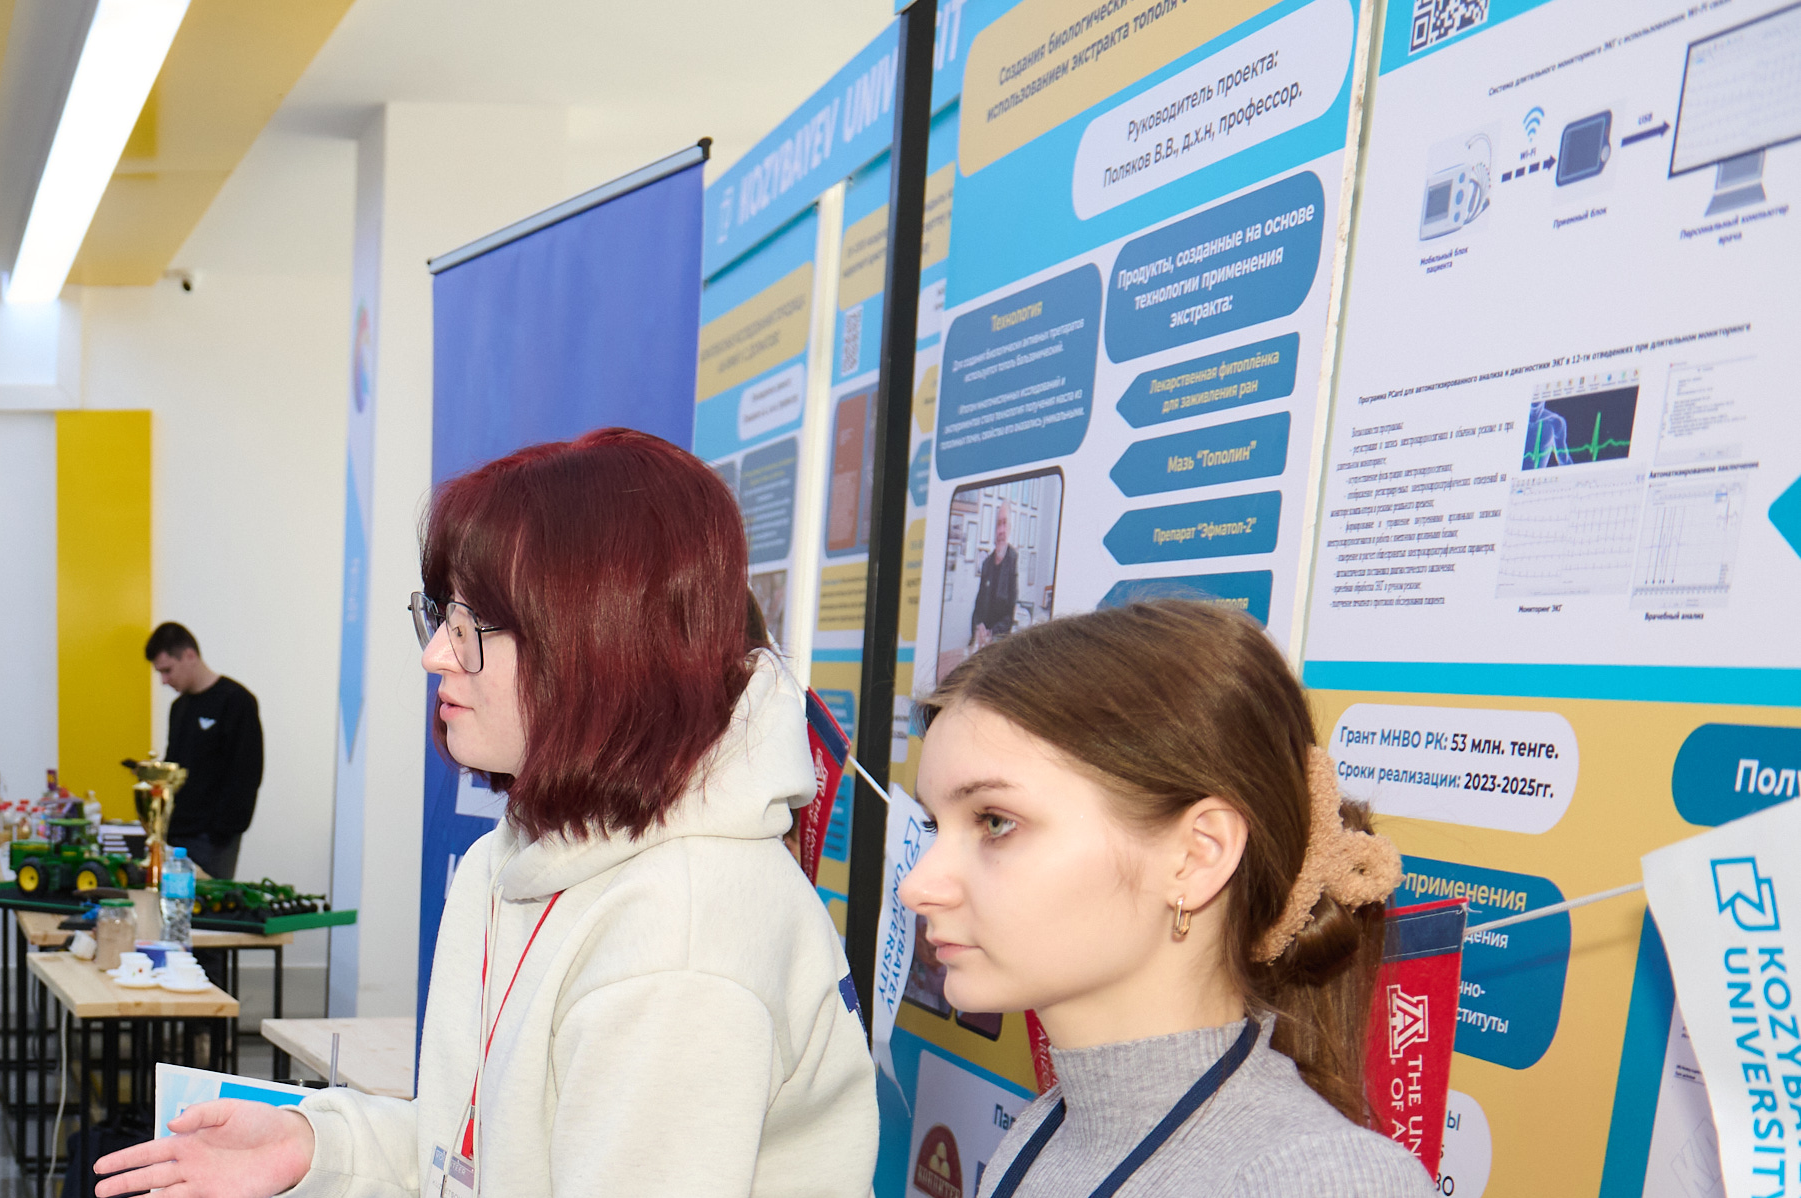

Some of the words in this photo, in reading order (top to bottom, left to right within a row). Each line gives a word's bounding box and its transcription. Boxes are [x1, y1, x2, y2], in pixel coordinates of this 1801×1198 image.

[987, 57, 1070, 123] использованием
[1071, 21, 1130, 71] экстракта
[999, 44, 1046, 86] Создания
[1127, 84, 1213, 141] Руководитель
[1216, 49, 1279, 98] проекта:
[1488, 82, 1514, 96] Система
[1103, 151, 1151, 188] Поляков
[1154, 137, 1179, 165] В.В.,
[1181, 121, 1215, 154] д.х.н,
[1218, 81, 1302, 135] профессор.
[1117, 258, 1174, 290] Продукты,
[1176, 230, 1243, 267] созданные
[1245, 223, 1262, 243] на
[1264, 204, 1315, 236] основе
[1134, 275, 1199, 310] технологии
[1201, 246, 1284, 291] применения
[991, 301, 1043, 332] Технология
[1169, 294, 1233, 328] экстракта:
[1149, 369, 1217, 394] Лекарственная
[1218, 351, 1280, 381] фитоплёнка
[1358, 391, 1387, 405] Программа
[1478, 370, 1503, 382] анализа
[1510, 361, 1550, 377] диагностики
[1636, 342, 1649, 354] при
[1650, 334, 1697, 352] длительном
[1162, 396, 1179, 414] для
[1180, 386, 1237, 409] заживления
[1239, 380, 1259, 399] ран
[1167, 455, 1194, 473] Мазь
[1153, 527, 1196, 545] Препарат
[1340, 726, 1376, 746] Грант
[1380, 729, 1421, 748] МНВО
[1425, 732, 1447, 750] РК:
[1451, 733, 1468, 752] 53
[1471, 738, 1505, 755] млн.
[1511, 740, 1560, 760] тенге.
[1338, 761, 1374, 780] Сроки
[1378, 766, 1461, 789] реализации:
[1464, 773, 1554, 798] 2023-2025гг.
[1391, 1078, 1404, 1112] OF
[1408, 1054, 1423, 1107] THE
